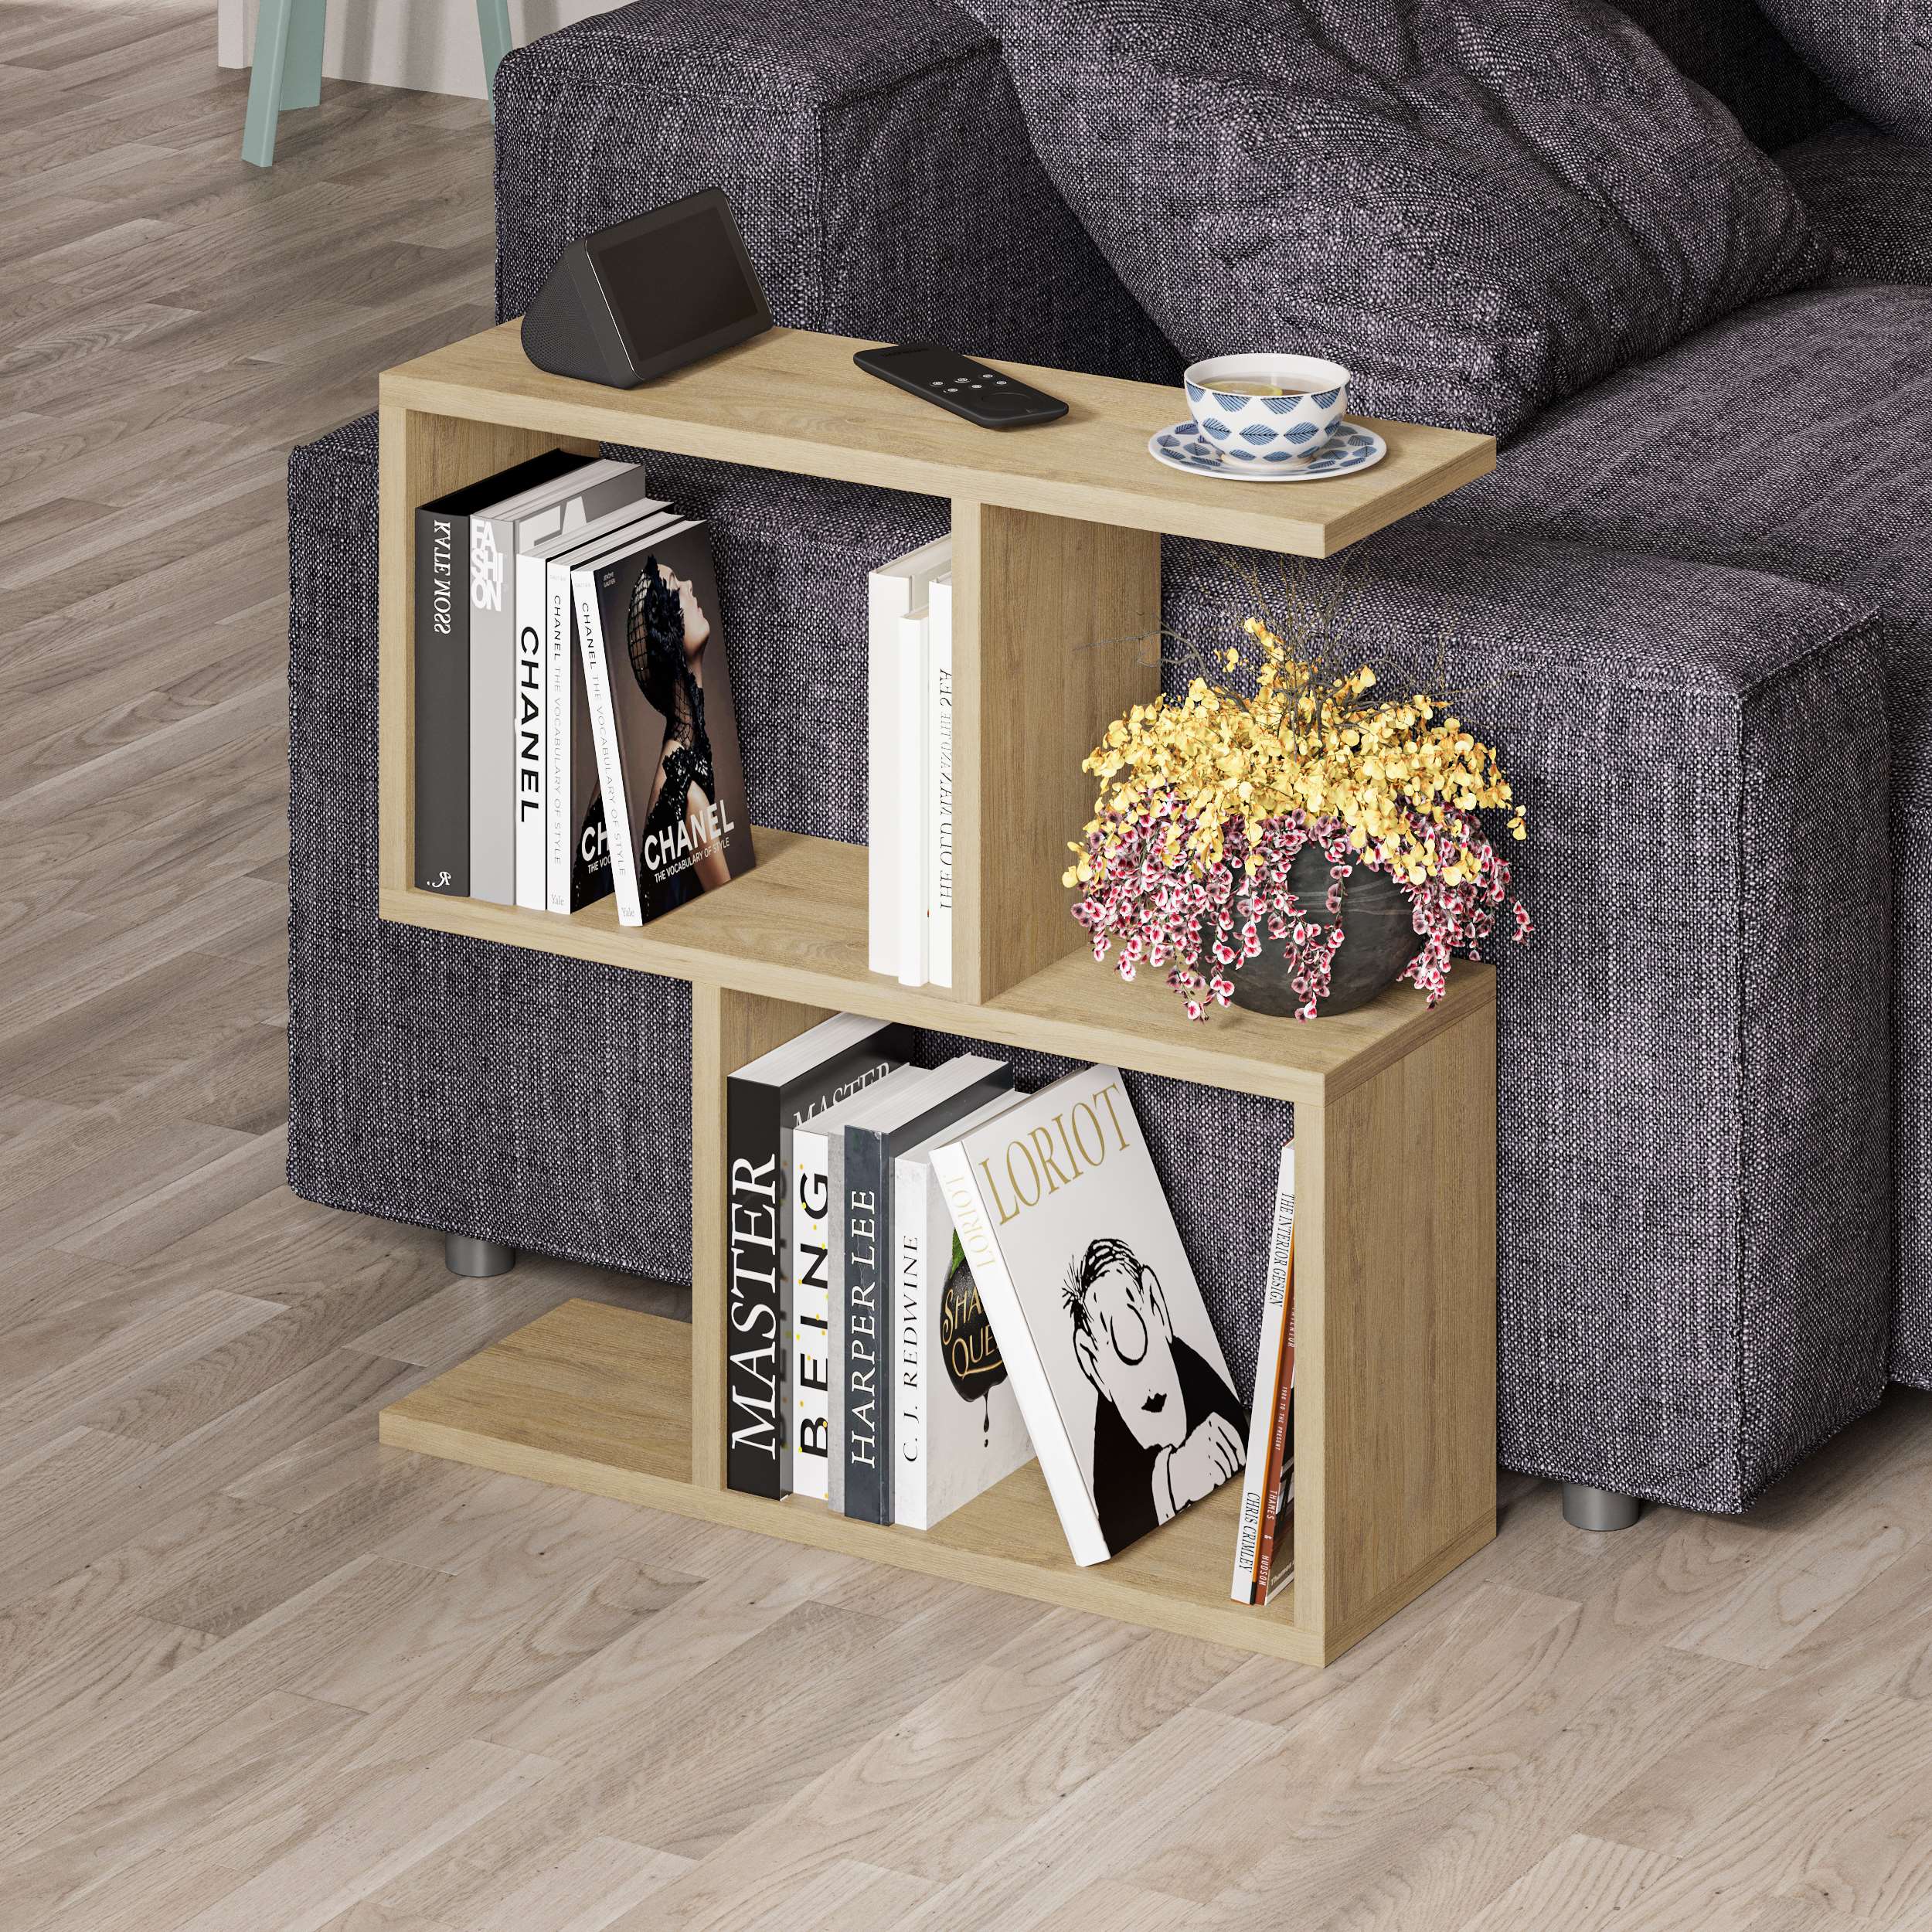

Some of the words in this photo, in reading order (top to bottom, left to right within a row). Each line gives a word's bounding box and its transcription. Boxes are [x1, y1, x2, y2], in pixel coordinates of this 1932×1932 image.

[471, 580, 502, 611] ON
[582, 603, 596, 669] CHANEL
[593, 675, 601, 701] THE
[521, 627, 539, 822] CHANEL
[597, 706, 616, 804] VOCABULARY
[554, 799, 561, 817] OF
[611, 808, 620, 828] OF
[614, 833, 626, 876] STYLE
[645, 799, 735, 870] CHANEL
[587, 860, 599, 874] THE
[654, 869, 667, 883] THE
[666, 851, 703, 878] VOCABULARY
[704, 846, 713, 857] OF
[713, 837, 730, 854] STYLE
[978, 1082, 1130, 1226] LORIOT
[944, 1175, 996, 1268] LORIOT
[1280, 1192, 1294, 1214] THE
[851, 1190, 876, 1270] LEE
[1274, 1216, 1292, 1266] INTERIOR
[730, 1153, 777, 1460] MASTER
[1269, 1268, 1287, 1308] GESIGN
[800, 1172, 828, 1458] BEING
[903, 1236, 918, 1390] REDWINE
[851, 1281, 876, 1468] HARPER
[951, 1324, 1002, 1379] QUE
[903, 1406, 920, 1424] J.
[903, 1437, 918, 1462] C.
[1275, 1426, 1284, 1451] PRESENT
[1245, 1492, 1260, 1524] CHRIS
[1267, 1490, 1277, 1520] THAMES
[1239, 1526, 1257, 1573] CRIMLEY
[1259, 1555, 1269, 1586] HUDSON
